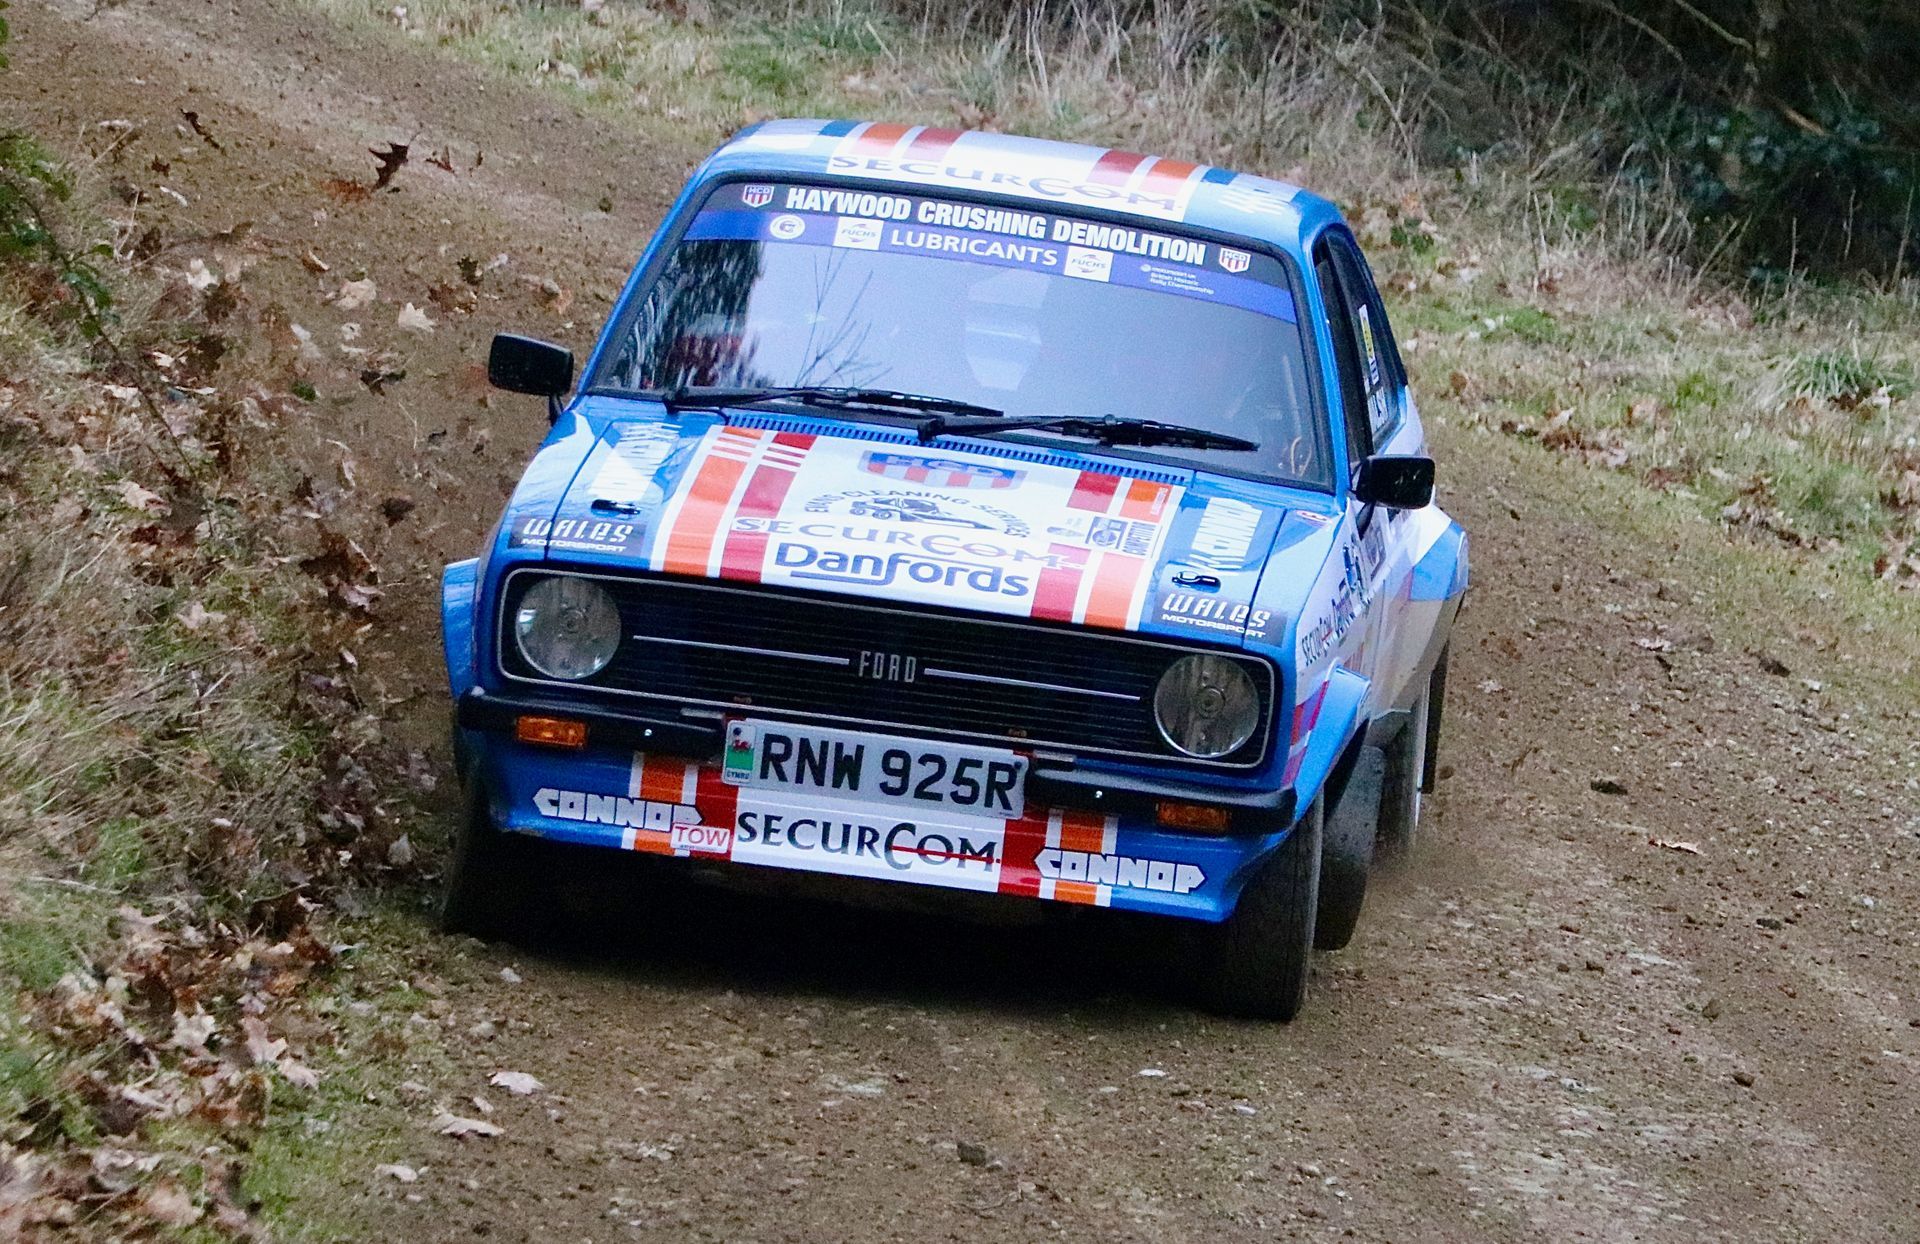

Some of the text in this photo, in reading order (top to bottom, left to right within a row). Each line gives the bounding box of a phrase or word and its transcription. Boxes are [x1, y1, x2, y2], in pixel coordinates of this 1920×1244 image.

[830, 154, 1179, 212] SECURCOM
[786, 187, 1207, 265] HAYWOOD CRUSHING DEMOLITION
[841, 228, 877, 238] FUCHS
[891, 229, 1058, 266] LUBRICANTS
[1070, 258, 1106, 269] FUCHS
[842, 490, 970, 505] CLEANING
[521, 538, 627, 553] MOTORSPORT
[522, 518, 634, 542] WALES
[735, 518, 1065, 570] SECURCOM
[774, 542, 1030, 597] Danfords
[1161, 614, 1267, 639] MOTORSPORT
[1162, 592, 1271, 629] WALES
[858, 650, 917, 683] FORD
[726, 769, 750, 780] CYMRU
[759, 733, 1018, 811] RNW 925R
[533, 786, 703, 832] CONNOP
[675, 825, 728, 847] TOW
[737, 811, 999, 872] SECURCOM
[1034, 847, 1206, 894] CONNOP
